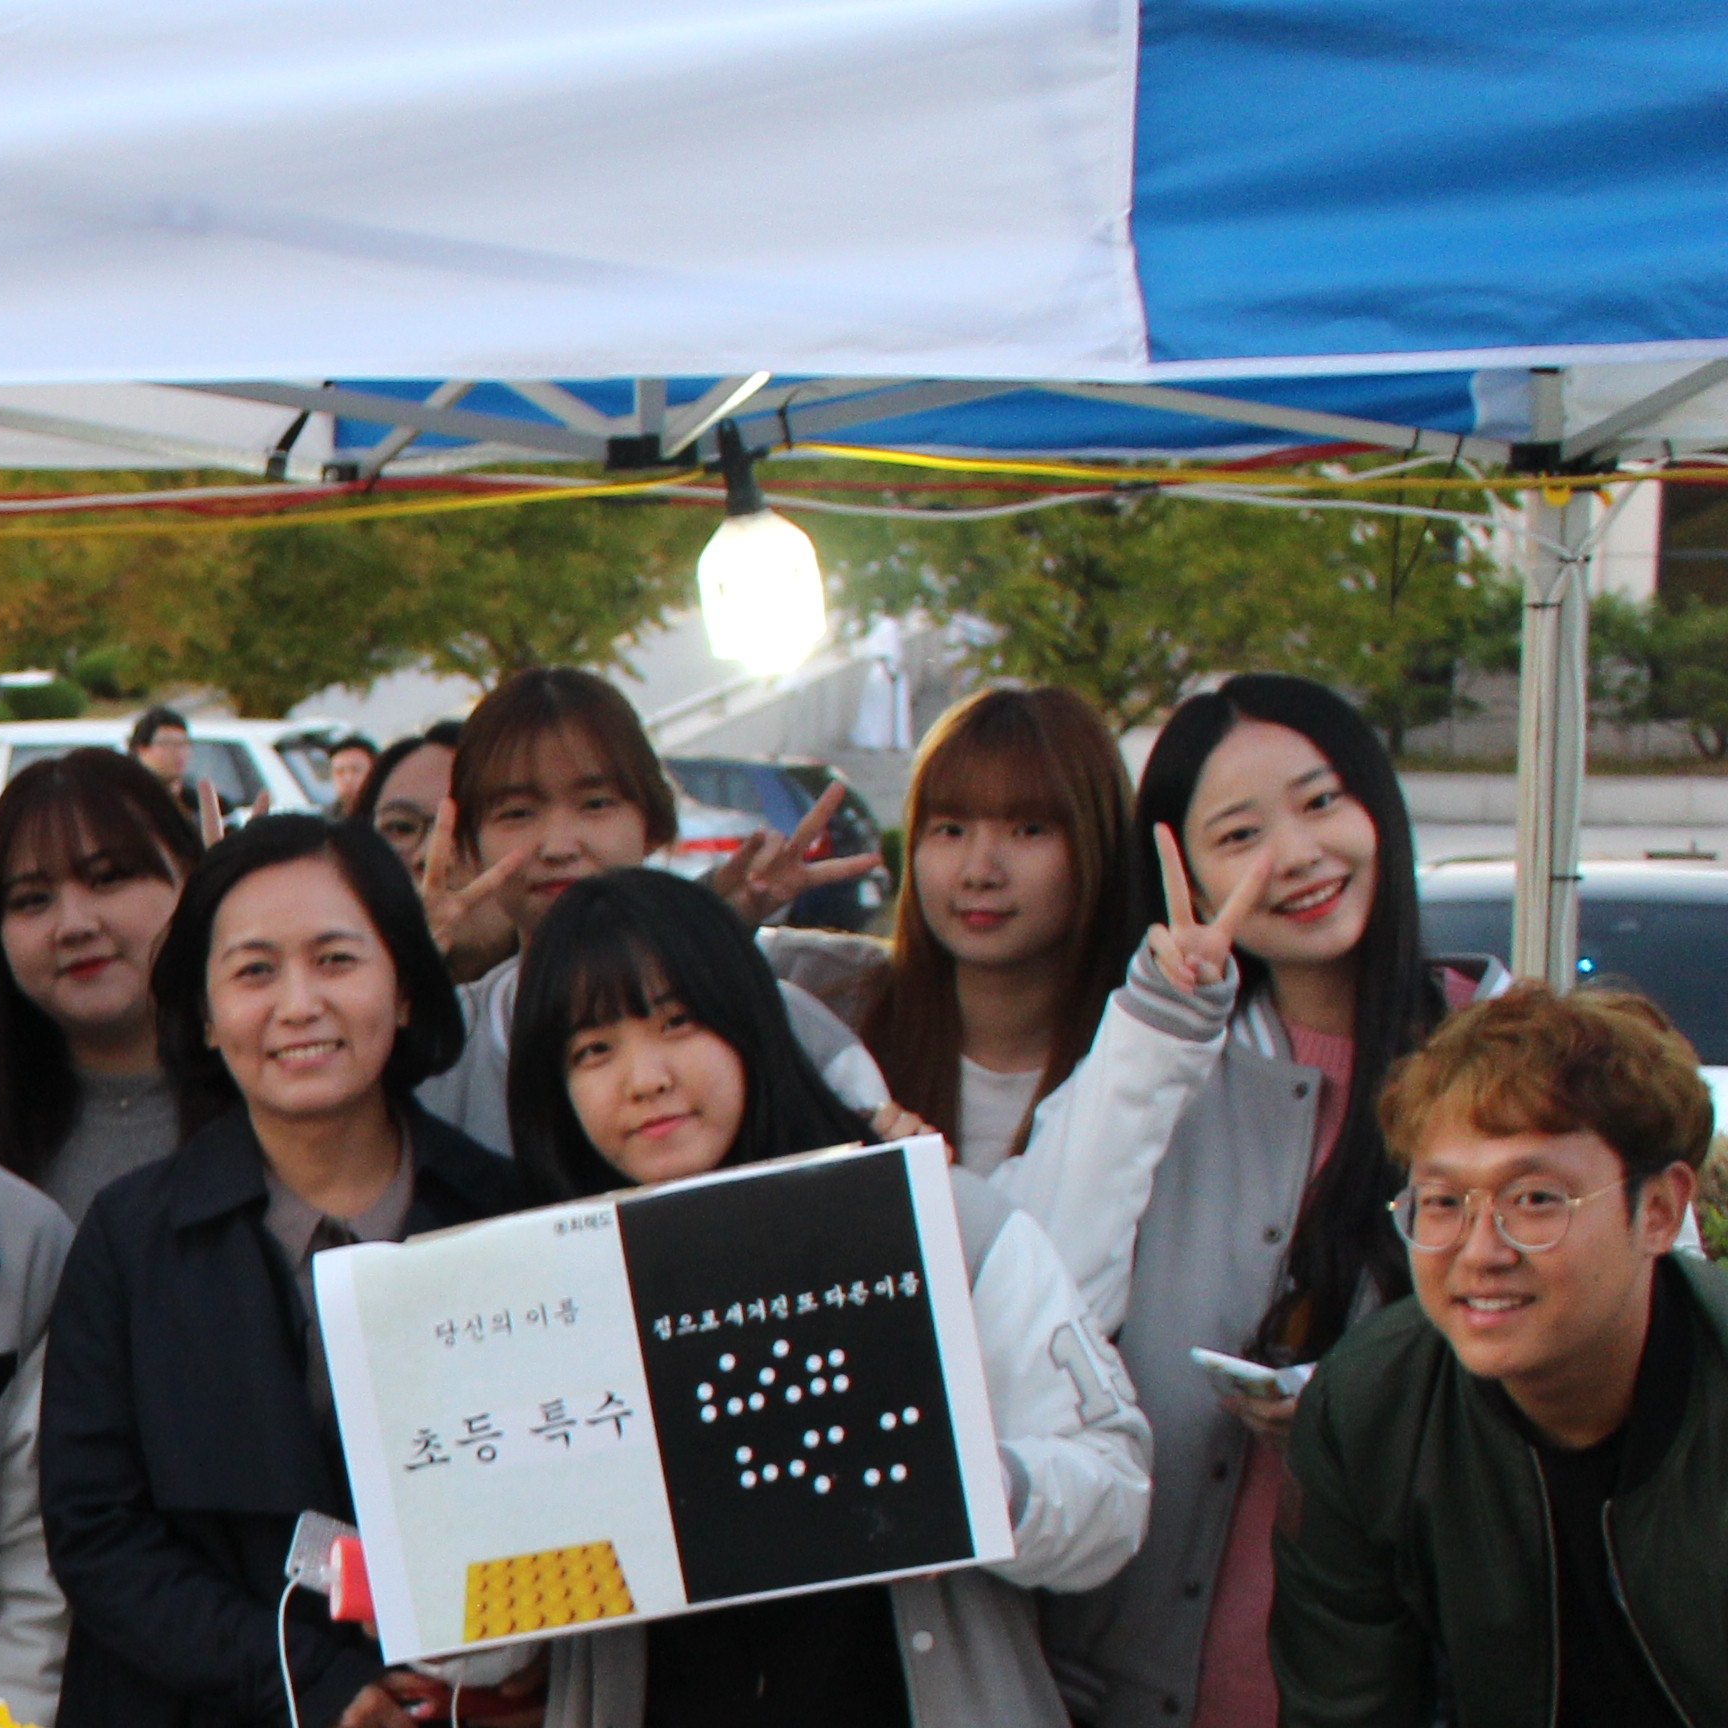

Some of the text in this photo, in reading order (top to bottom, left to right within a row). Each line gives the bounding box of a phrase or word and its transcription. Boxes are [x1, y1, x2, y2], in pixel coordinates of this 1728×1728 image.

[435, 1296, 579, 1347] 당신의 이름
[653, 1308, 720, 1341] 점으로
[796, 1290, 819, 1314] 또
[823, 1280, 870, 1309] 다른
[874, 1270, 920, 1301] 이름
[403, 1390, 634, 1471] 초등 특수
